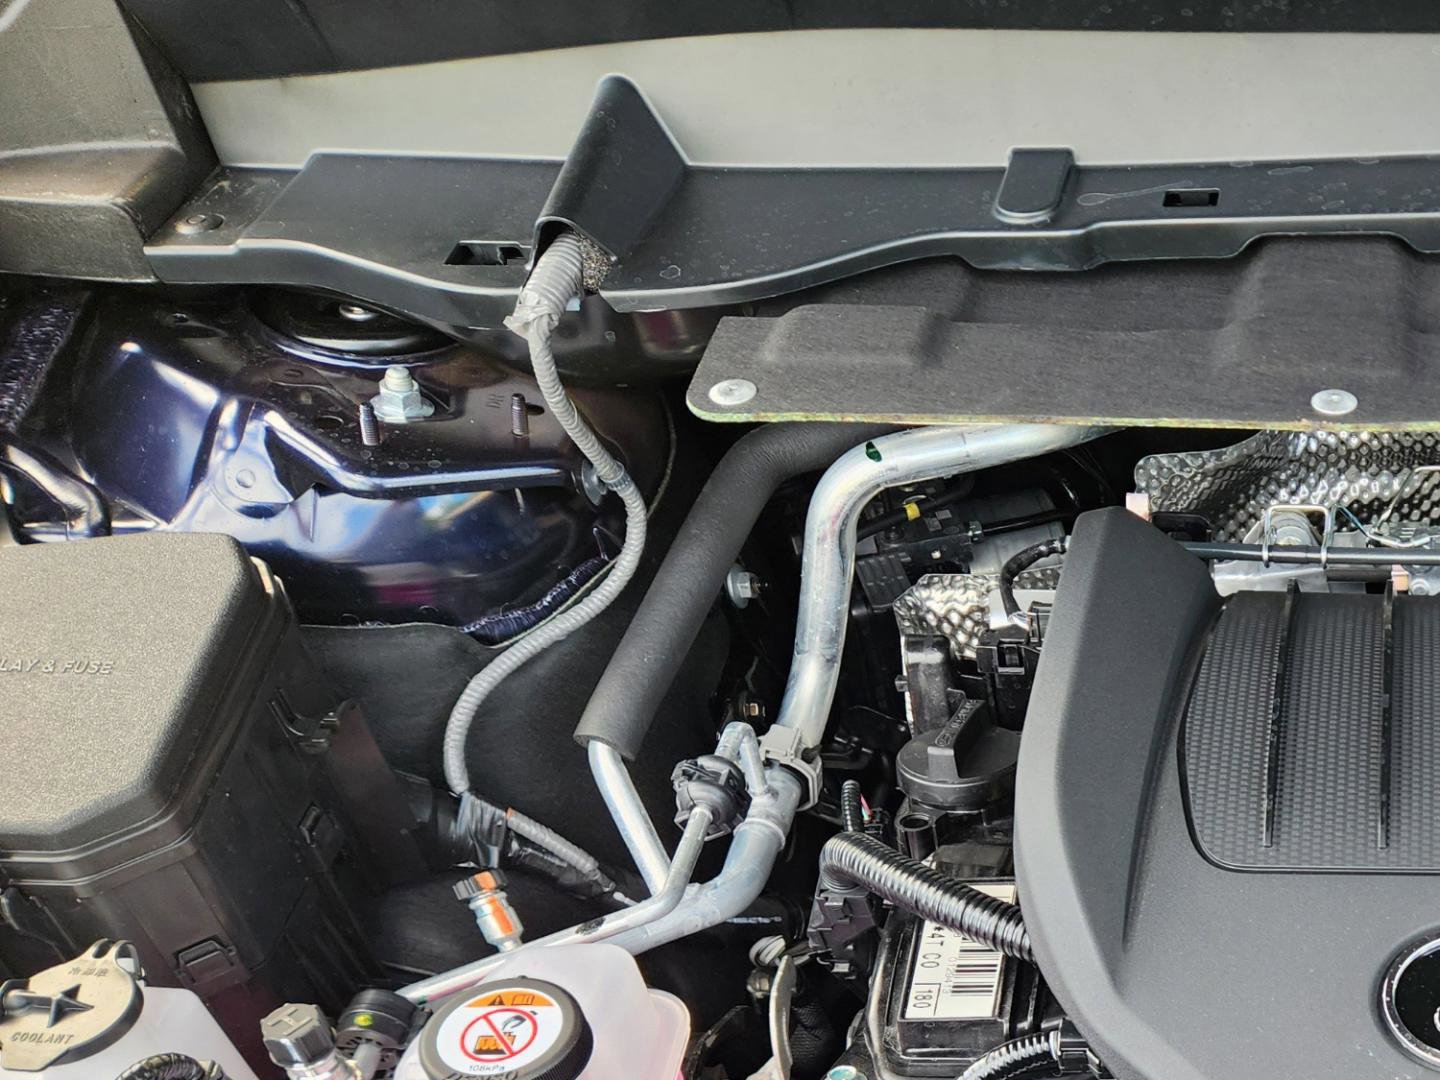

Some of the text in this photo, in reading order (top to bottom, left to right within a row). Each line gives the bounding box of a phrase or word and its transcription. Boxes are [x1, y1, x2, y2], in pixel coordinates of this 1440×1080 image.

[42, 659, 55, 673] &
[62, 659, 115, 675] FUSE
[912, 989, 933, 1009] 180
[11, 1031, 75, 1045] COOLANT
